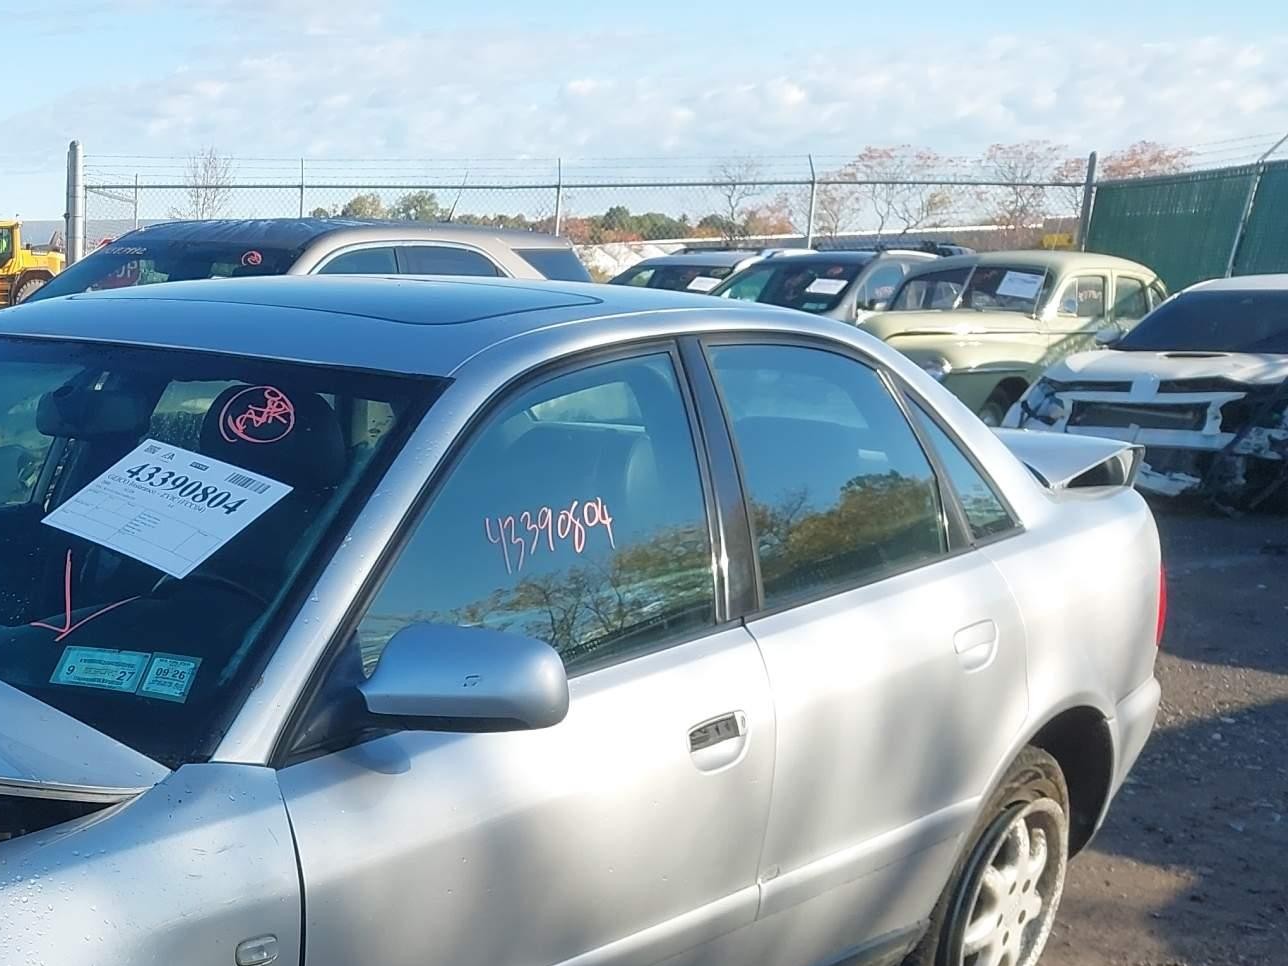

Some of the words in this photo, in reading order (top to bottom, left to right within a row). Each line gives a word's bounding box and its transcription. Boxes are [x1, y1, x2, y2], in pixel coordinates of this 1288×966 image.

[126, 463, 249, 515] 43390804
[485, 496, 616, 575] 43390804
[66, 665, 76, 676] 9
[117, 670, 136, 682] 27
